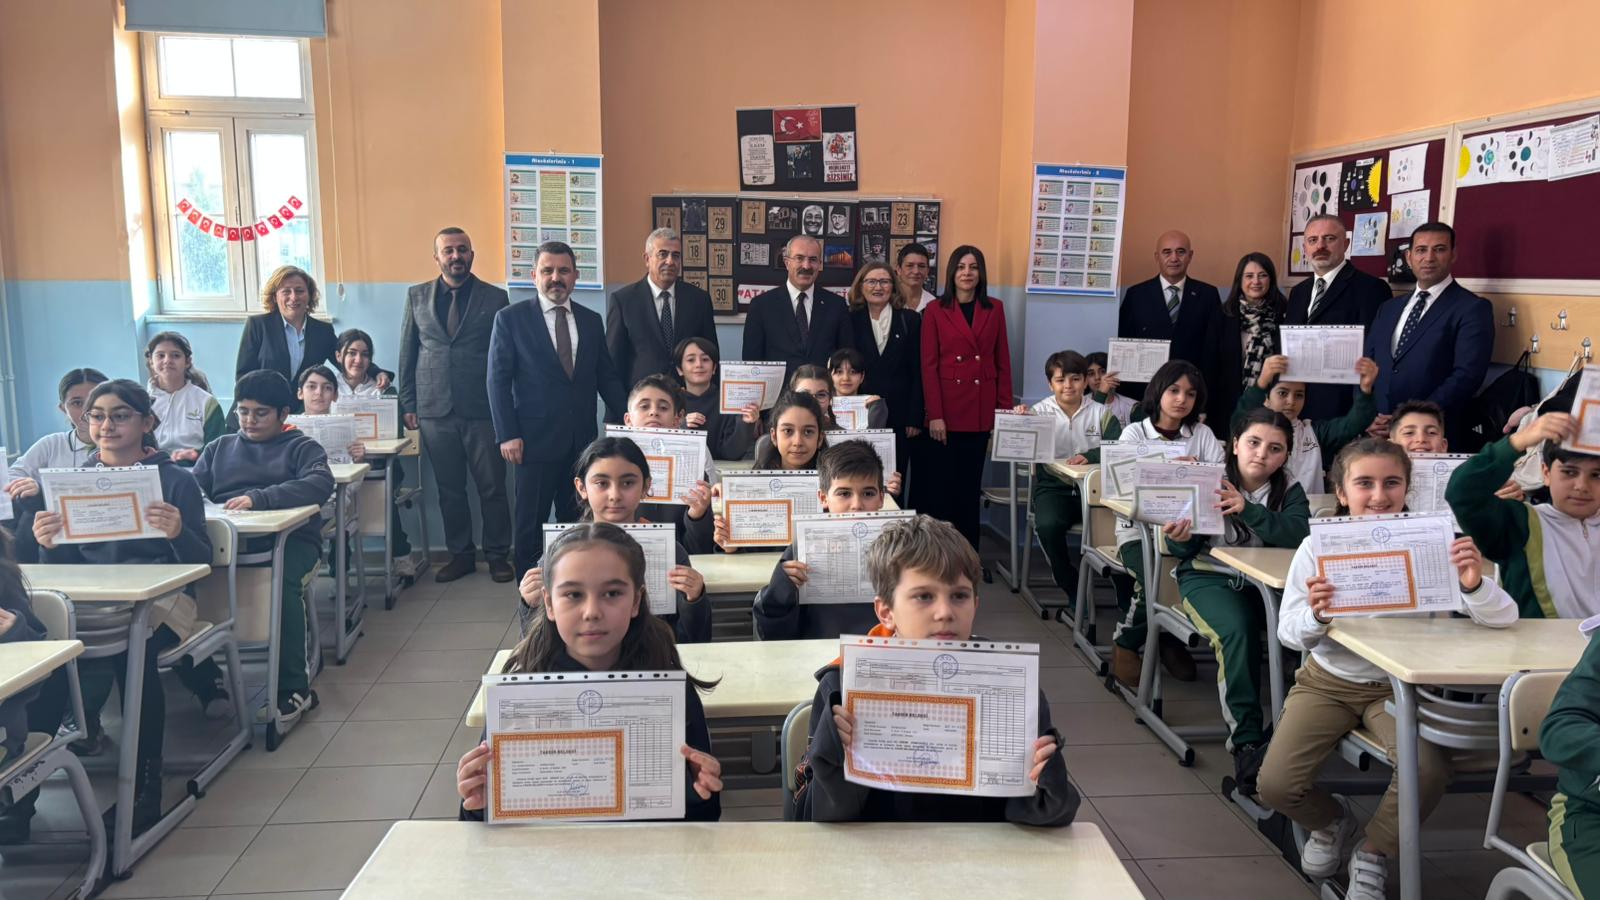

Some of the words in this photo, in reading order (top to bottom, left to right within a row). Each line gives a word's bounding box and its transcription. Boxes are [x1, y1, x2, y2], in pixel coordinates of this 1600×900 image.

[715, 217, 725, 230] 29
[751, 211, 756, 225] 4
[897, 213, 908, 226] 23
[690, 244, 699, 258] 18
[717, 254, 725, 266] 19
[716, 288, 726, 301] 30
